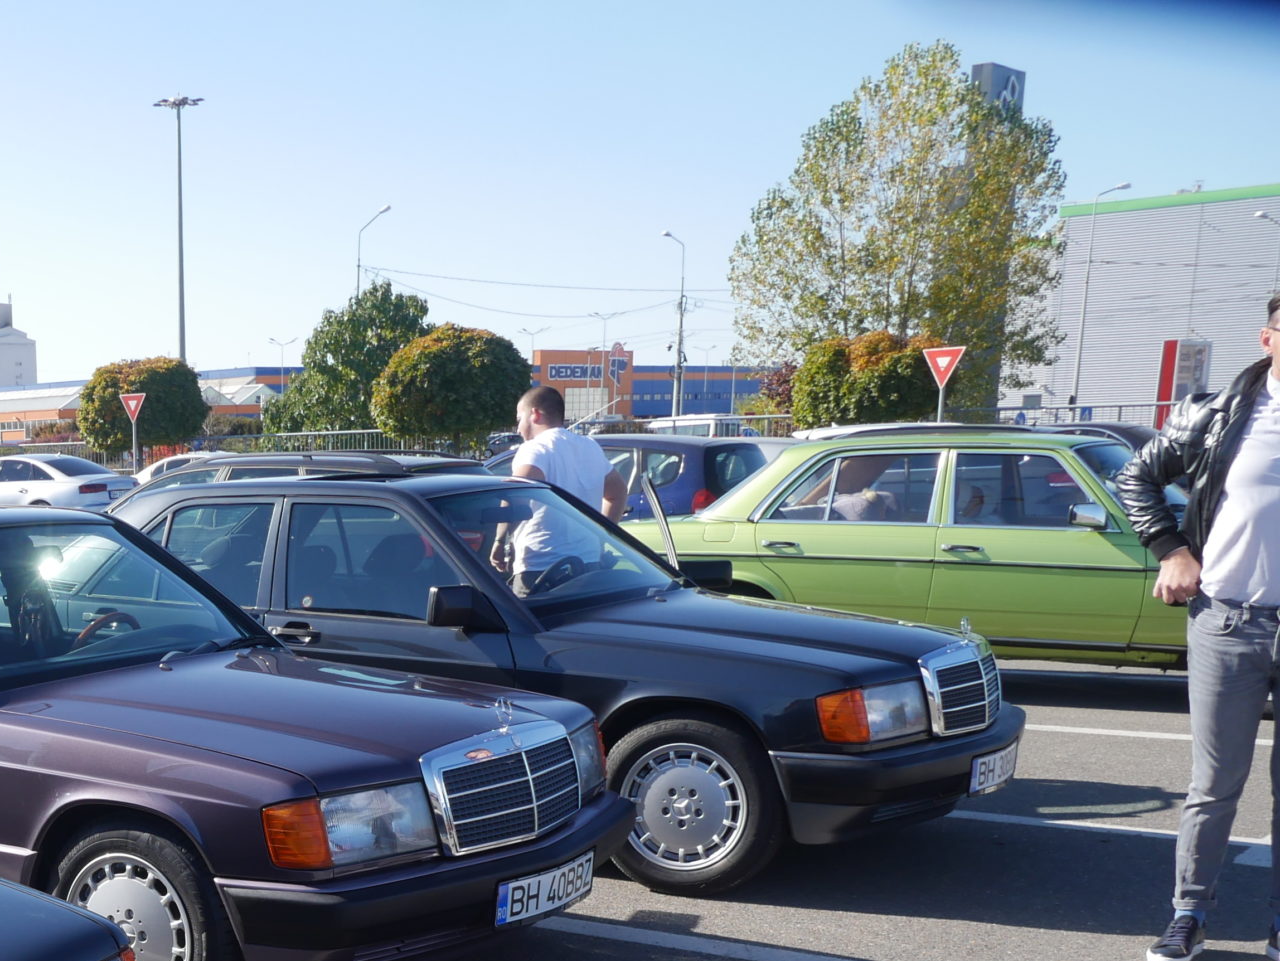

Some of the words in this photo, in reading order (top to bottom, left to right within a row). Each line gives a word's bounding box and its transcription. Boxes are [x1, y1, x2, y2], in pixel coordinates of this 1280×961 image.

[548, 364, 603, 380] DEDEMAN
[978, 757, 997, 787] BH
[510, 880, 541, 918] BH
[547, 857, 593, 904] 40BBZ
